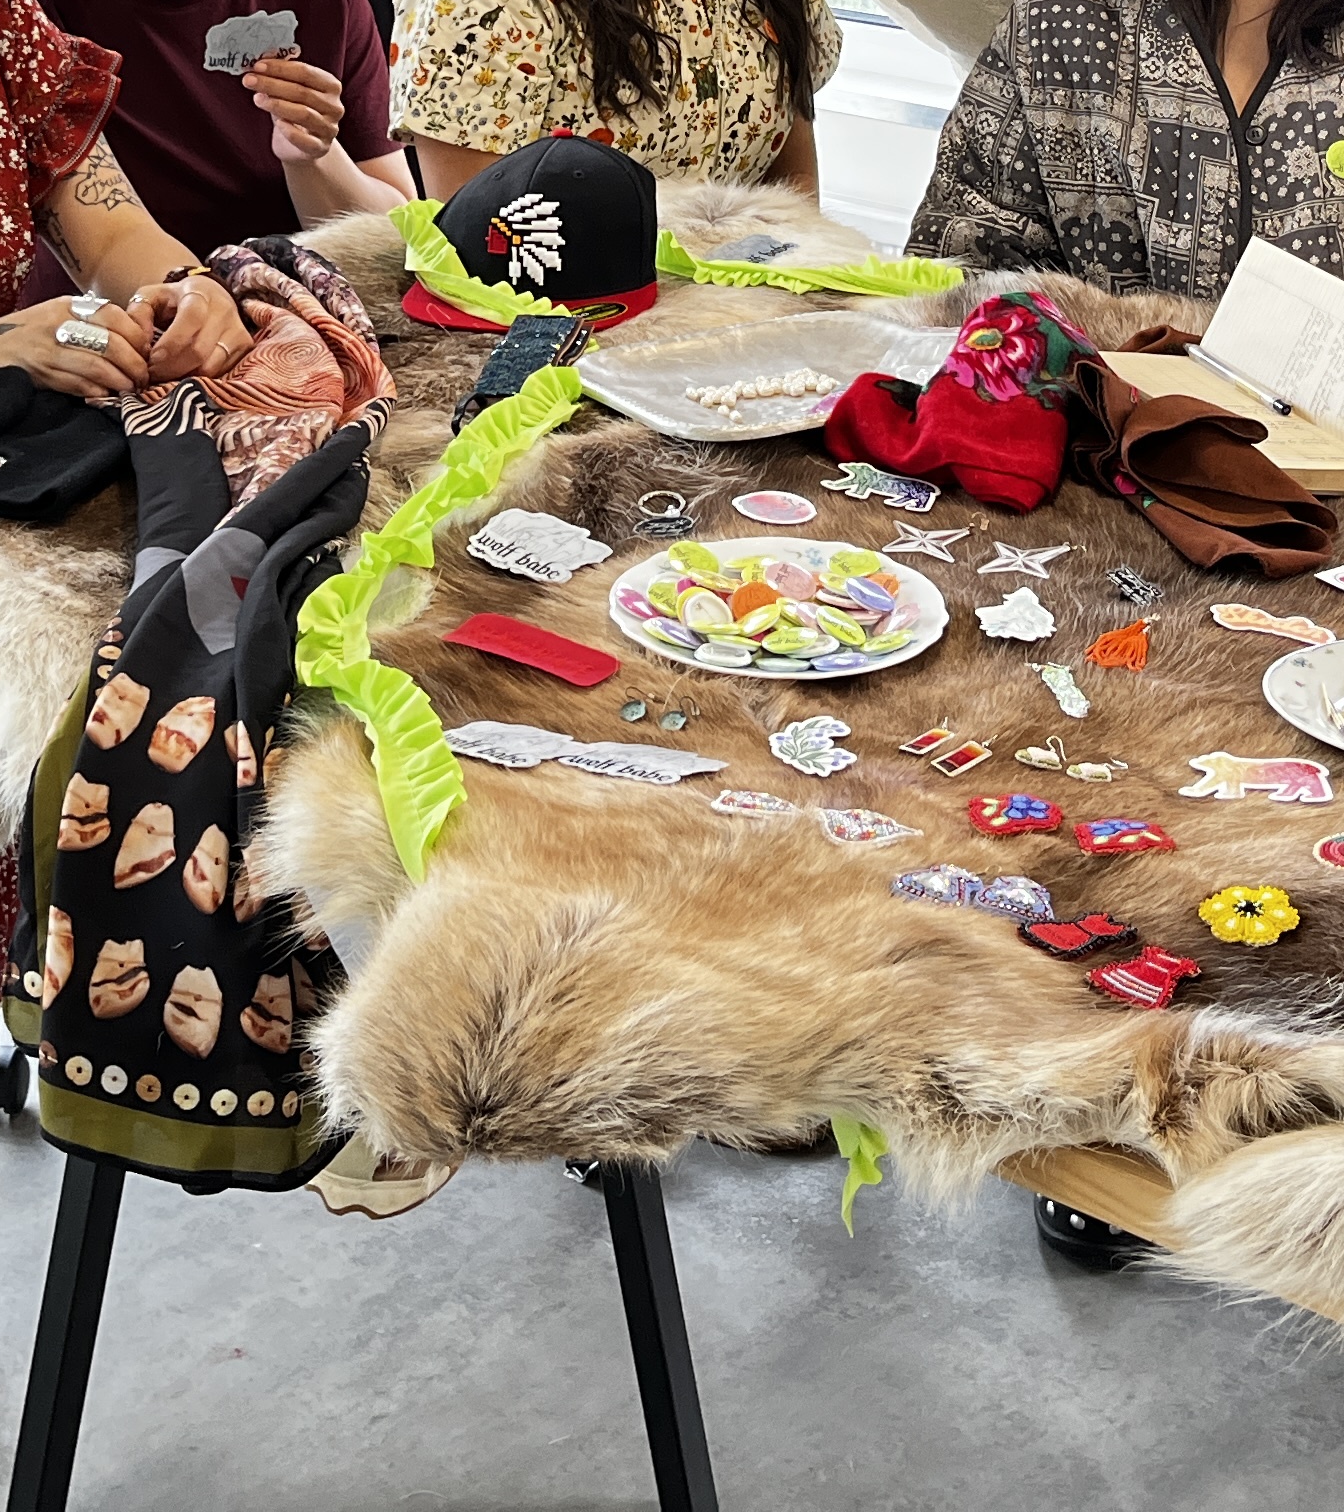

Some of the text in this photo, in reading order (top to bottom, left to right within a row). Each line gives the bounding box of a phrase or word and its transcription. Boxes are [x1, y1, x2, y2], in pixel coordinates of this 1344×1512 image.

[208, 51, 240, 68] wolf
[476, 532, 560, 580] wolf babe
[476, 746, 528, 765] babe
[567, 754, 673, 782] wolf babe
